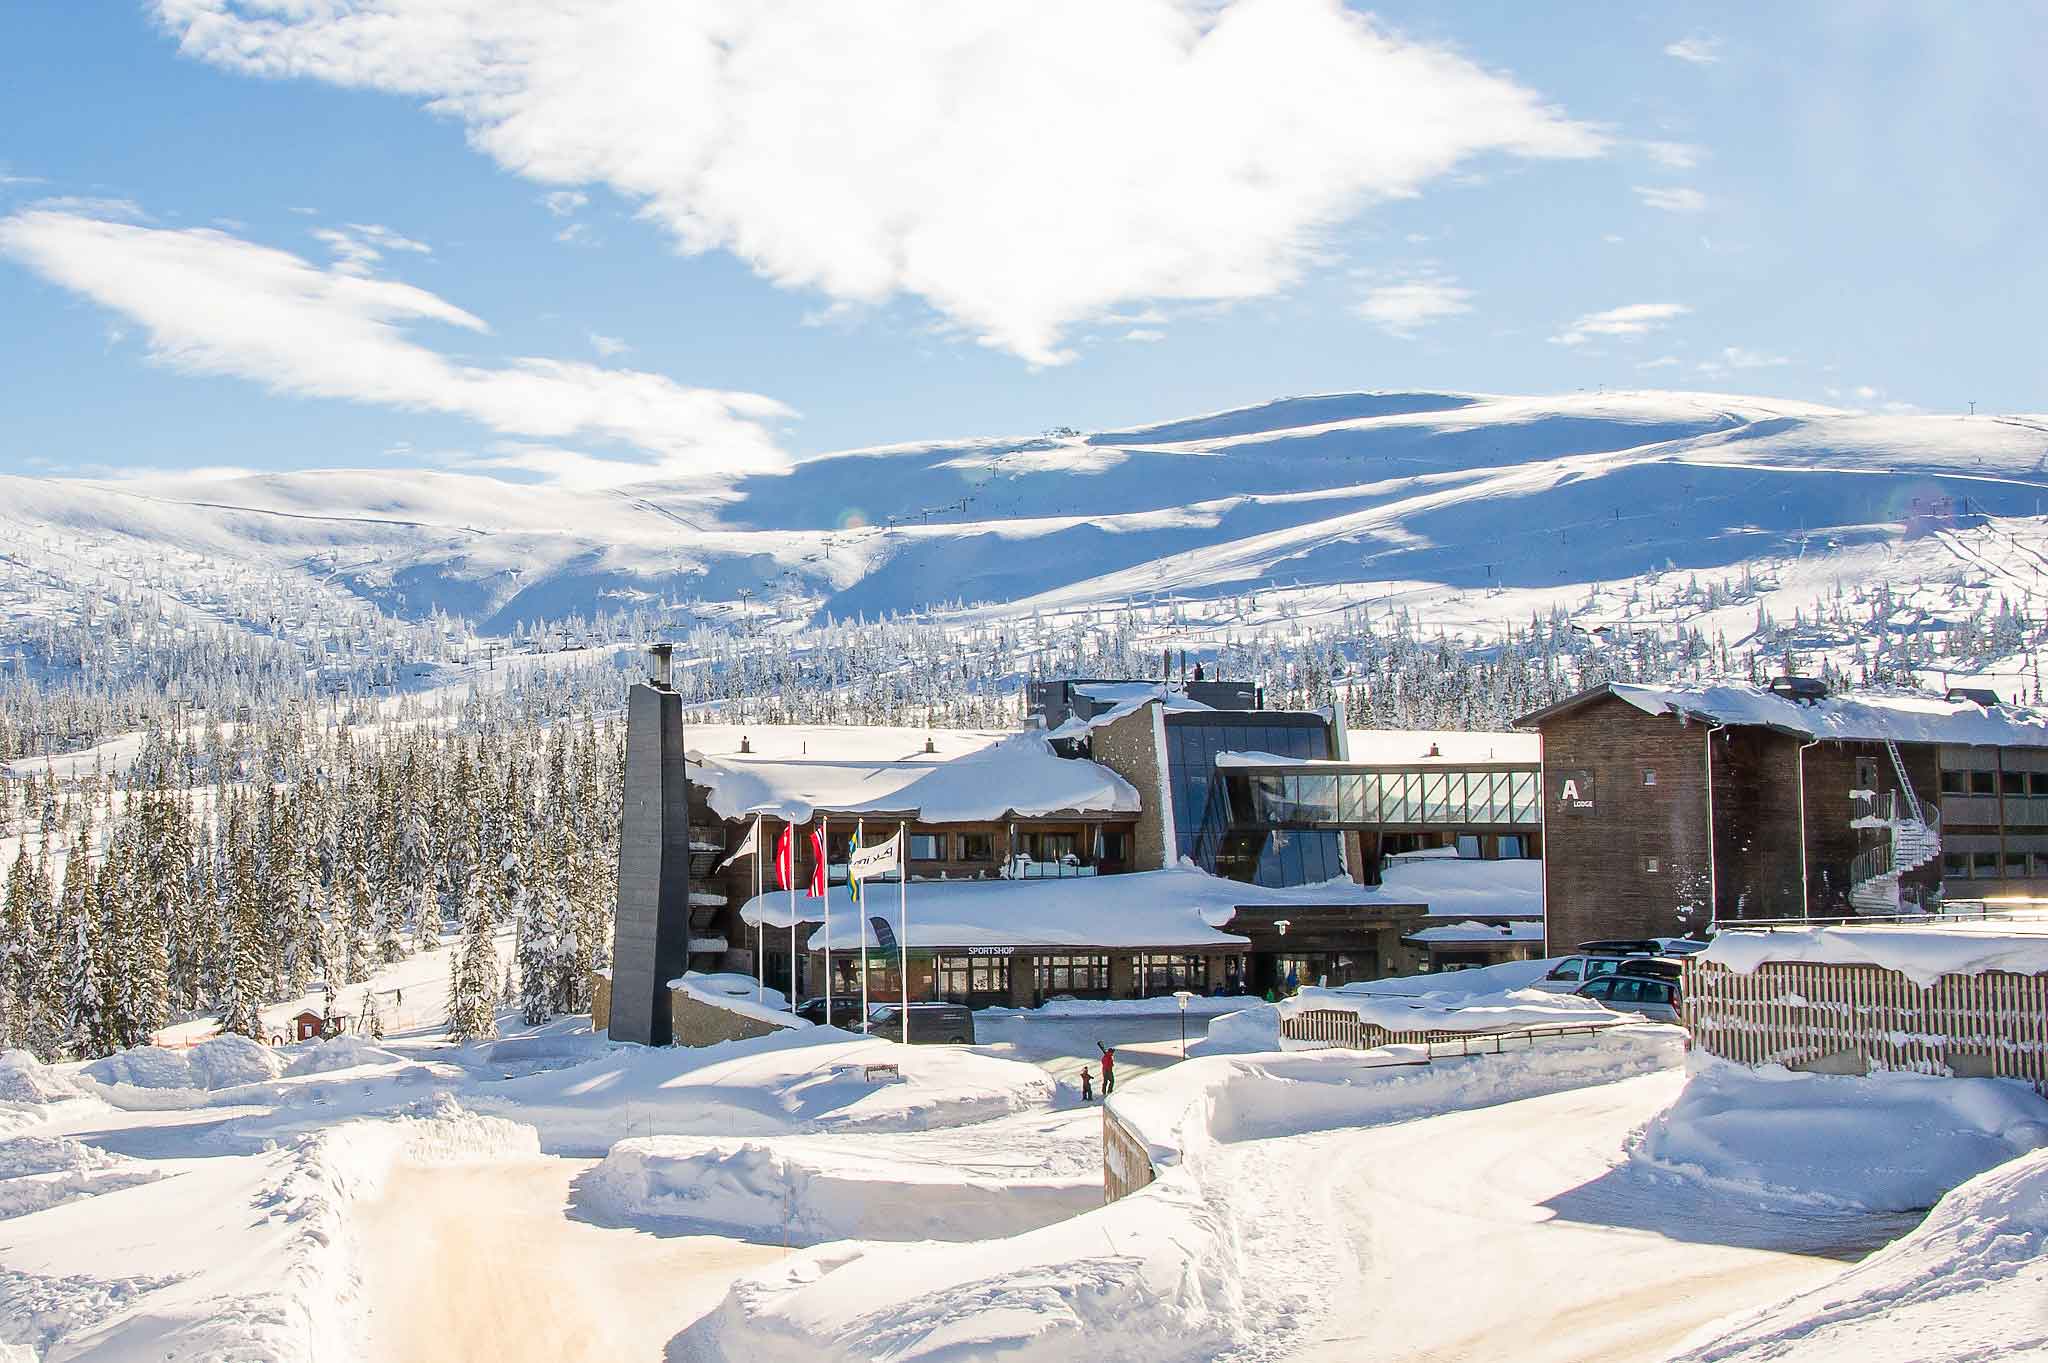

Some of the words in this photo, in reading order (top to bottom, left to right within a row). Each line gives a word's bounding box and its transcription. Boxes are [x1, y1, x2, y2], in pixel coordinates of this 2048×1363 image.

[1561, 779, 1578, 800] A
[1573, 800, 1593, 808] LODGE
[968, 947, 1014, 955] SPORTSHOP
